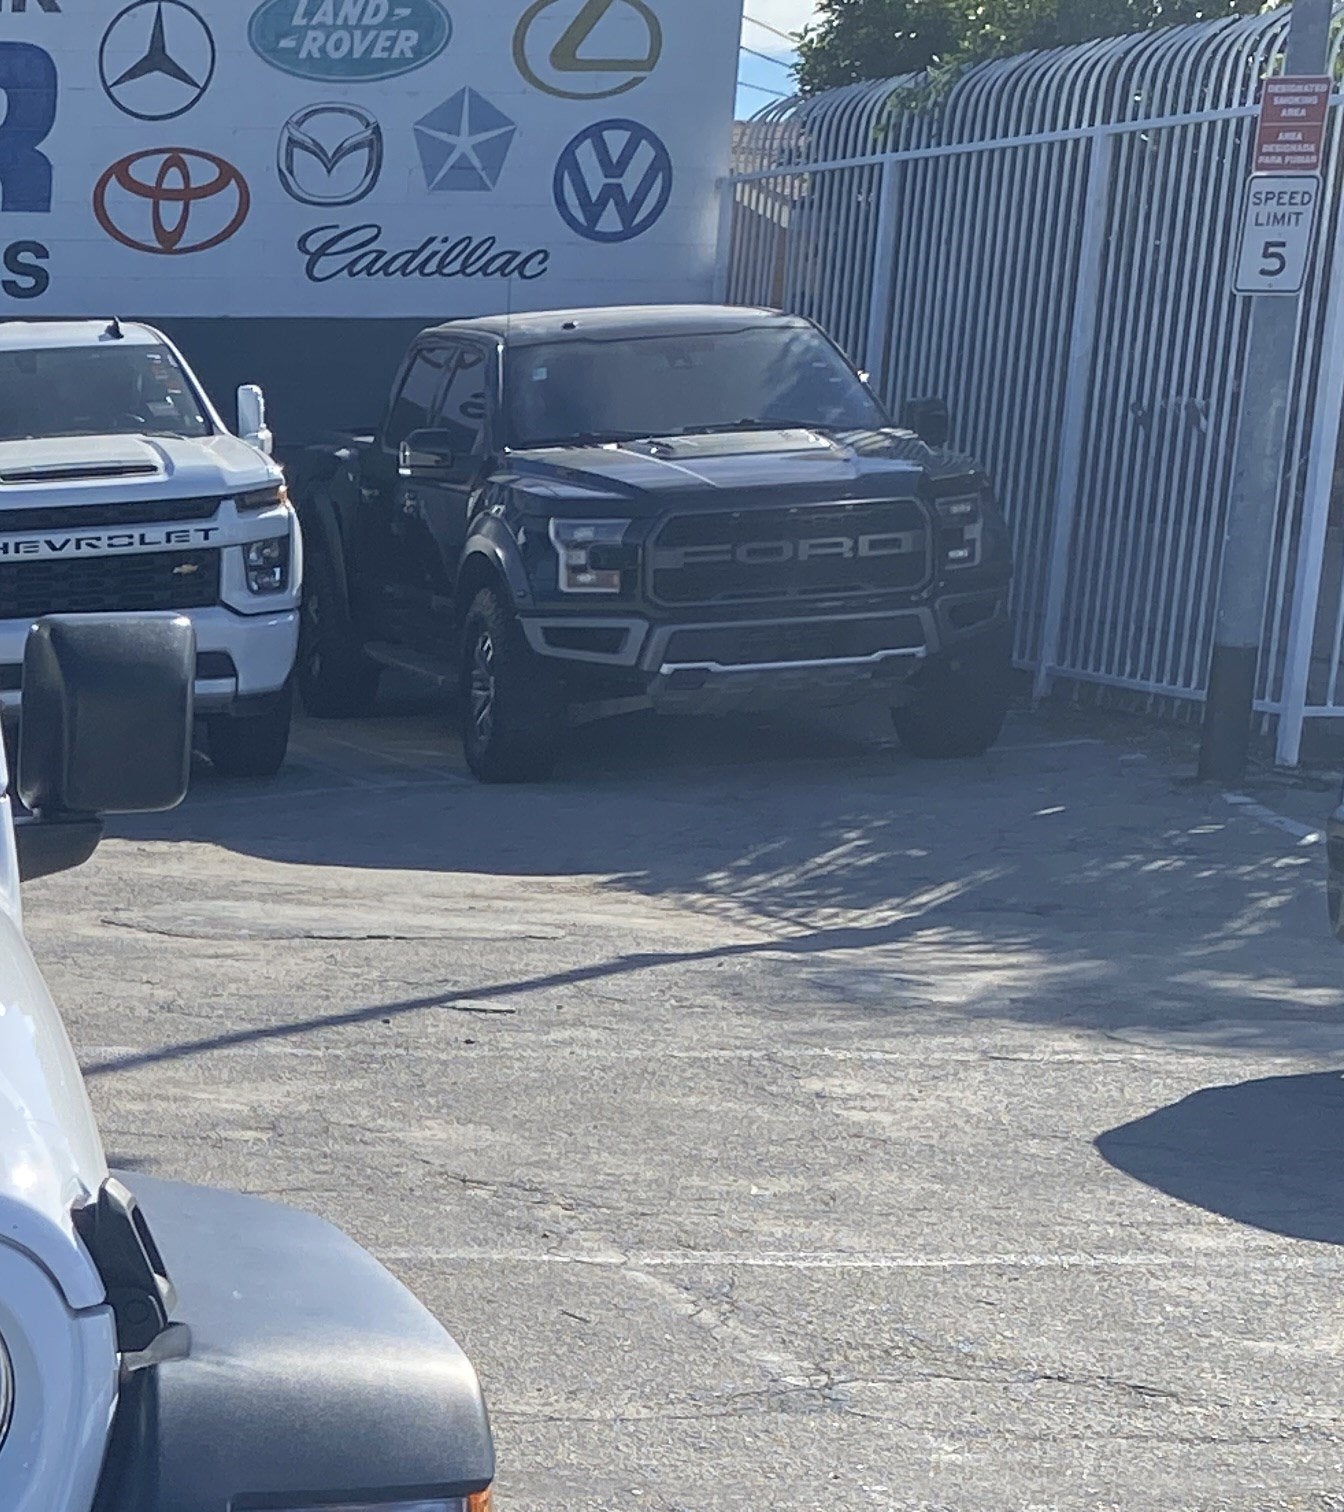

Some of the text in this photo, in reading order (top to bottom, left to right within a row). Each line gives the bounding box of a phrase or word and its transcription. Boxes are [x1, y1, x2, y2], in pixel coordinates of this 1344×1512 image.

[1251, 190, 1313, 207] SPEED
[1254, 211, 1303, 228] LIMIT
[297, 224, 550, 283] Cadillac
[1258, 240, 1287, 277] 5
[648, 530, 922, 568] FORD
